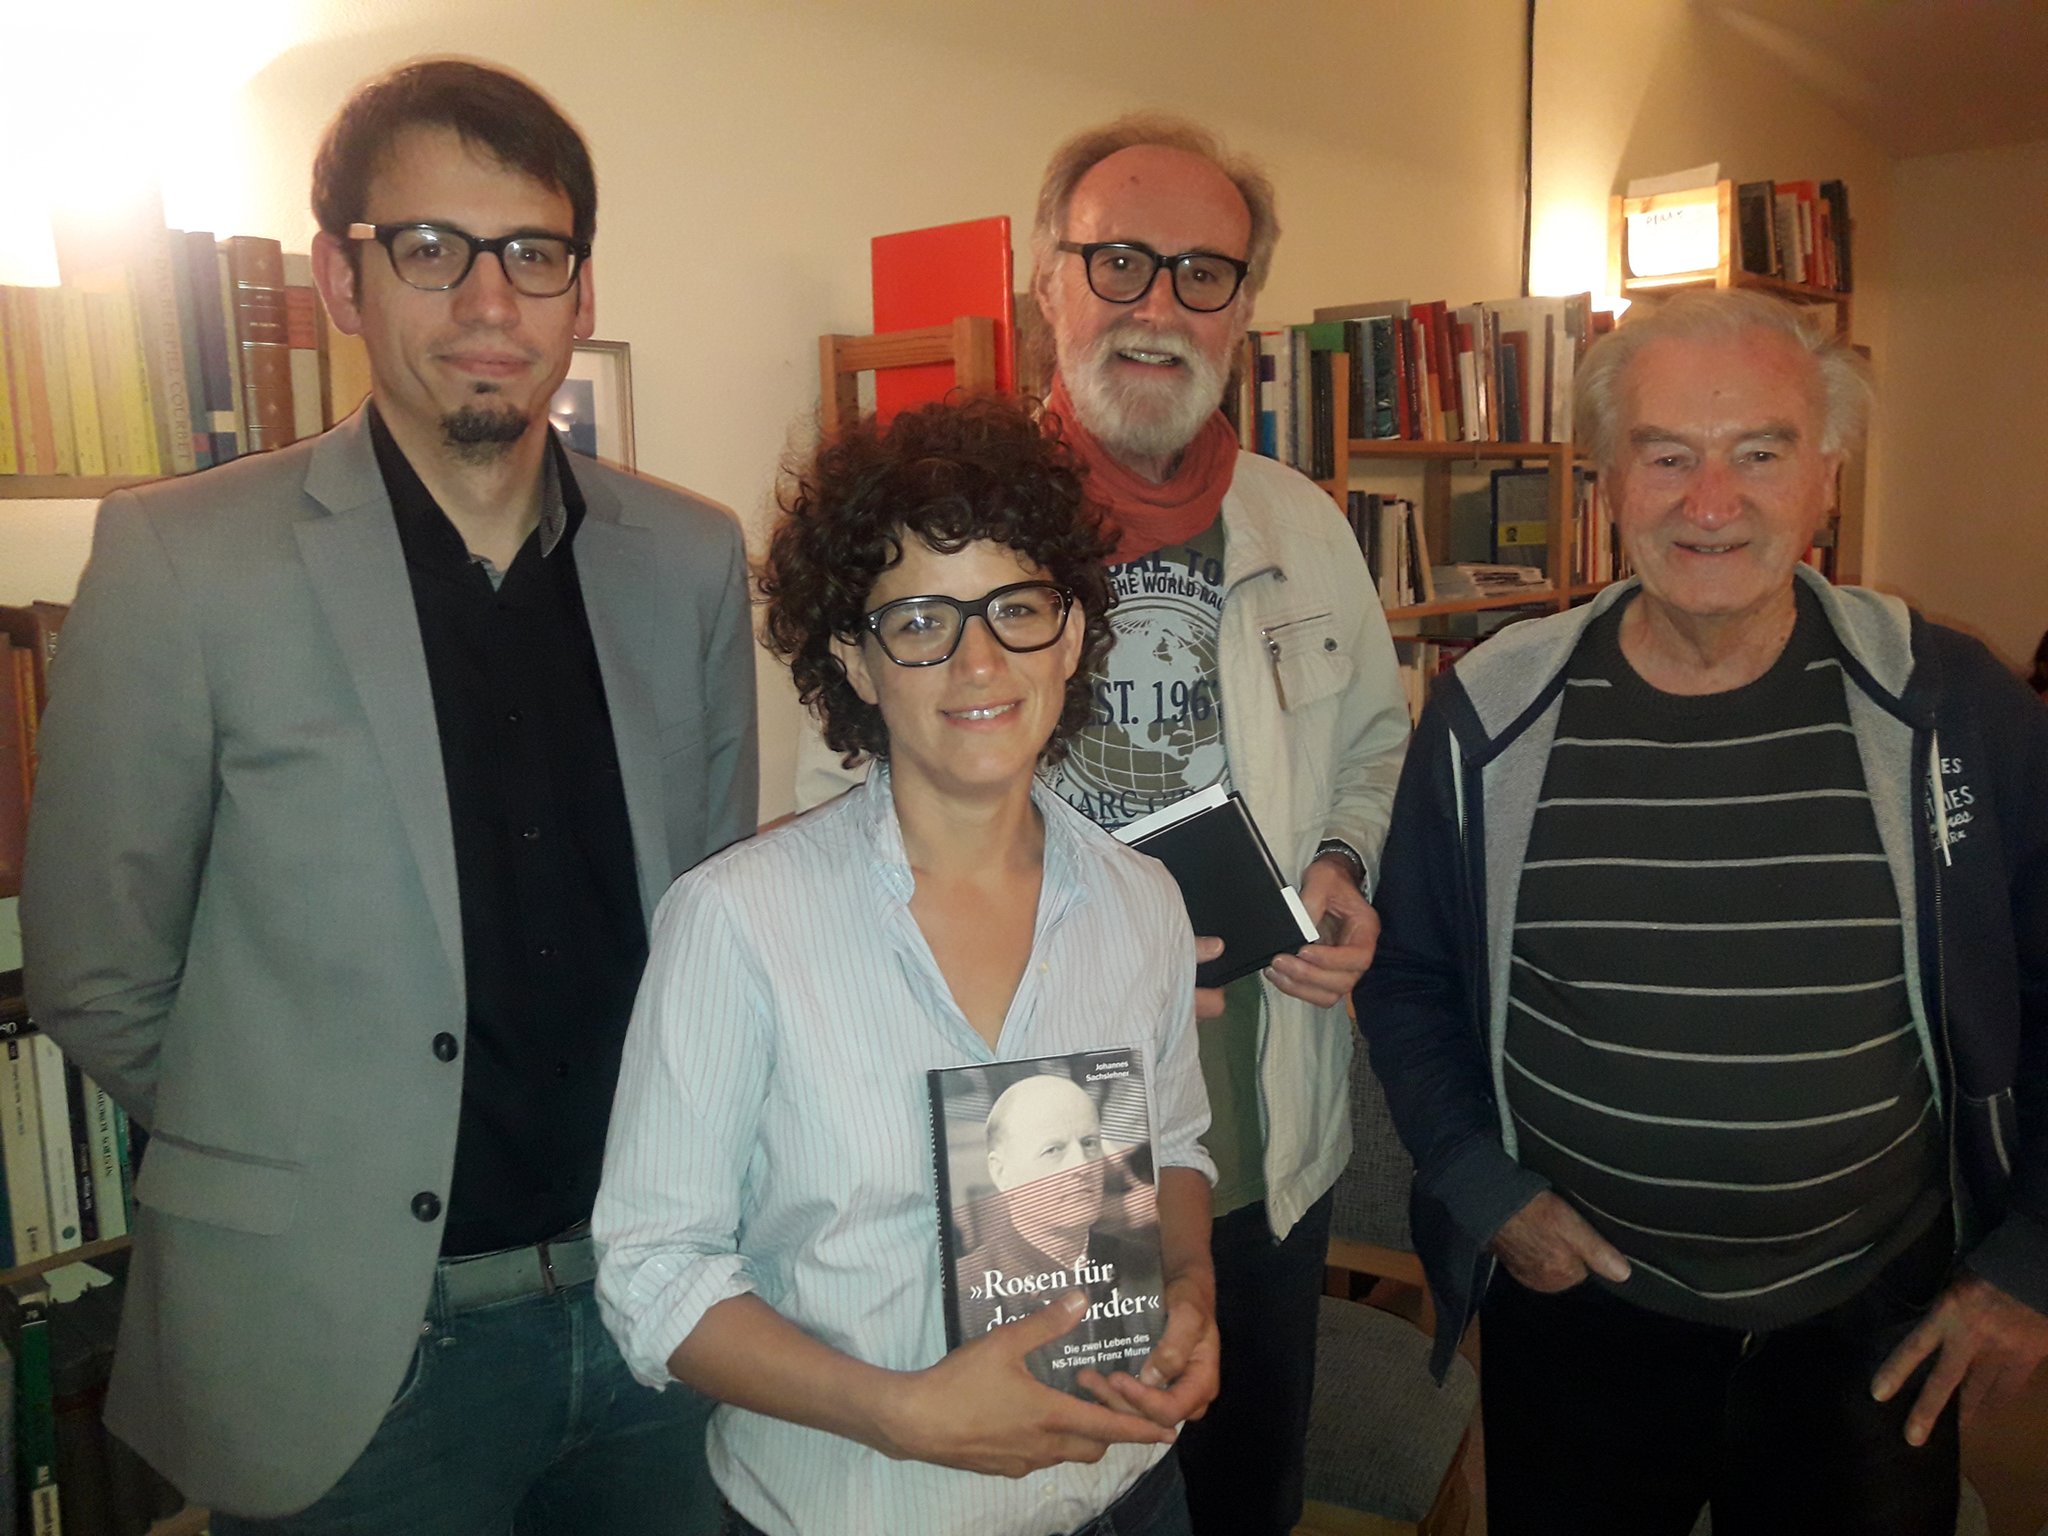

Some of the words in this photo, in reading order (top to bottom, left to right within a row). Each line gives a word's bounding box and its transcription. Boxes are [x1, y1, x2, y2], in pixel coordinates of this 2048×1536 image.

[168, 379, 192, 462] COURBET
[1143, 575, 1195, 597] WORLD
[1089, 680, 1139, 725] ST.
[1152, 679, 1222, 724] 196
[1095, 1061, 1129, 1071] Johannes
[969, 1269, 1069, 1300] »Rosen
[1074, 1255, 1114, 1286] für
[1064, 1343, 1080, 1355] Die
[1082, 1342, 1102, 1352] zwei
[1104, 1336, 1131, 1348] Leben
[1133, 1333, 1150, 1343] des
[1052, 1354, 1095, 1370] NS-Täters
[1098, 1351, 1122, 1362] Franz
[1124, 1346, 1151, 1358] Murer
